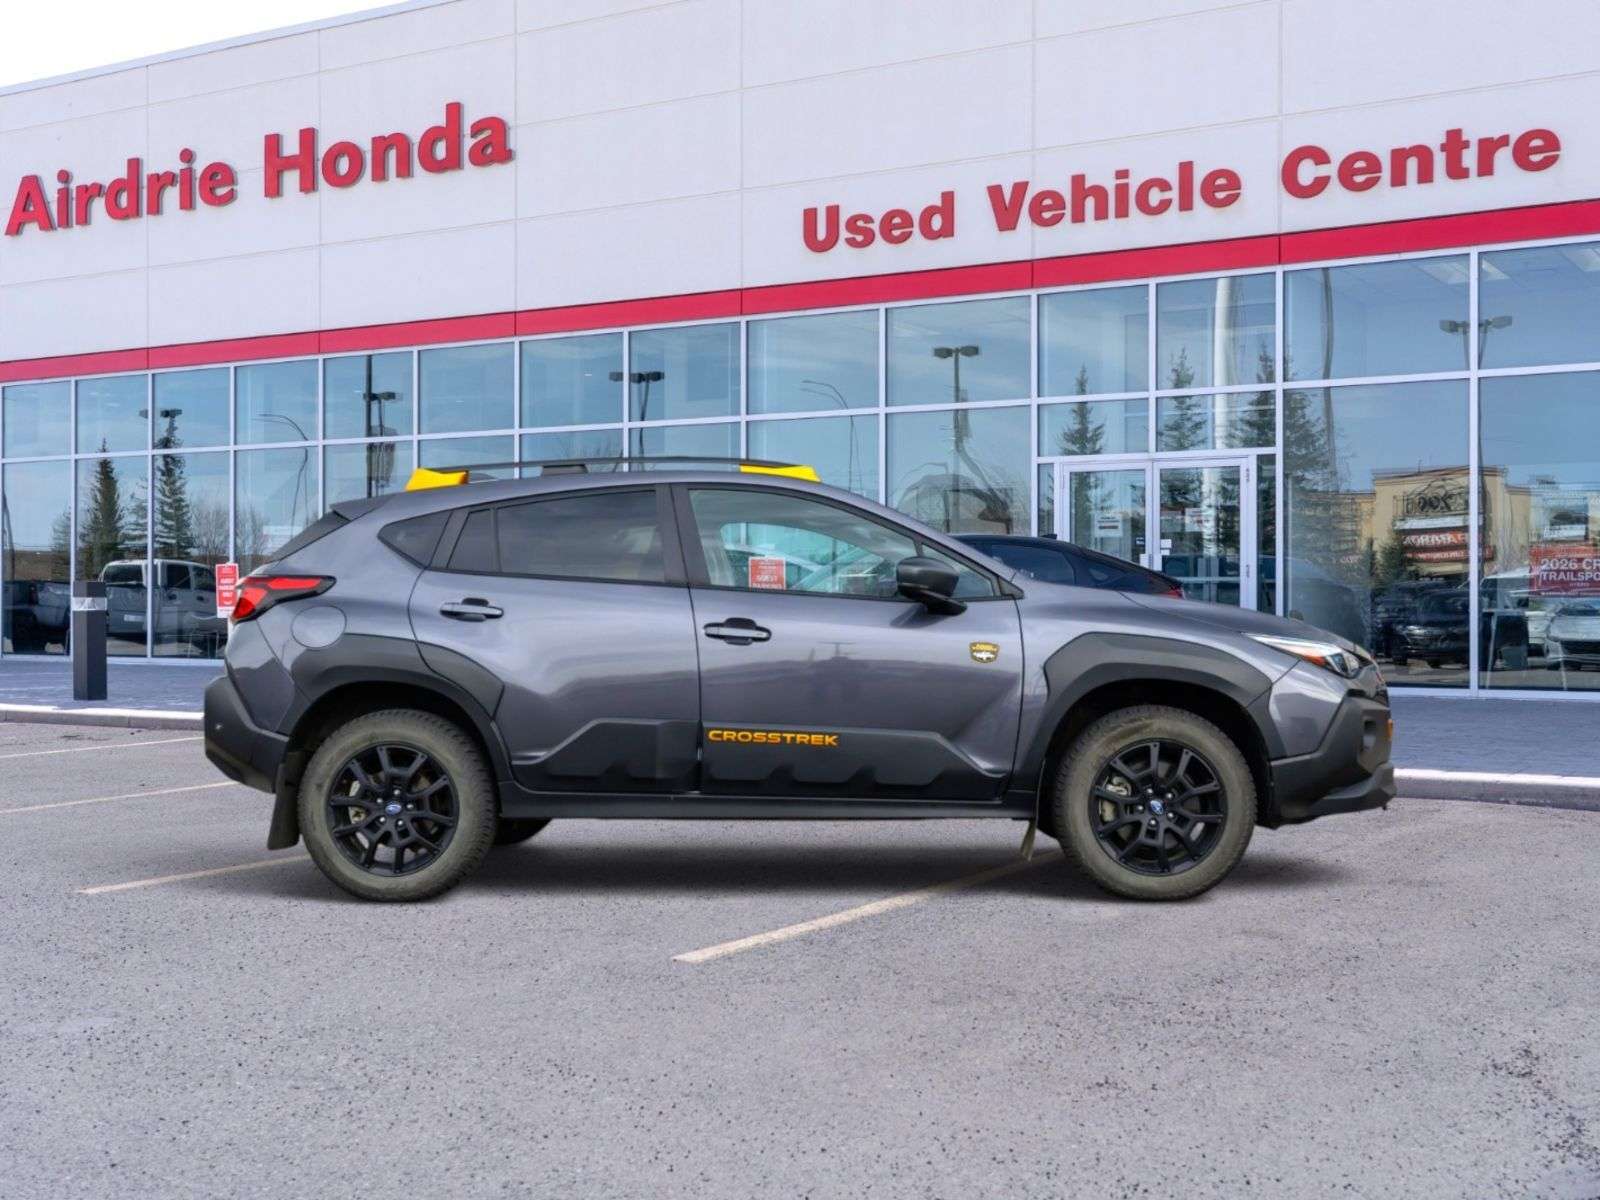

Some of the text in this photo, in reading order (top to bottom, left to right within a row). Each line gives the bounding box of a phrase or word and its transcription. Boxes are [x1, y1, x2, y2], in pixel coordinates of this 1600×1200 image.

[5, 102, 513, 237] Airdrie Honda
[803, 128, 1562, 253] Used Vehicle Centre
[1541, 558, 1578, 571] 2026
[707, 729, 839, 746] CROSSTREK
